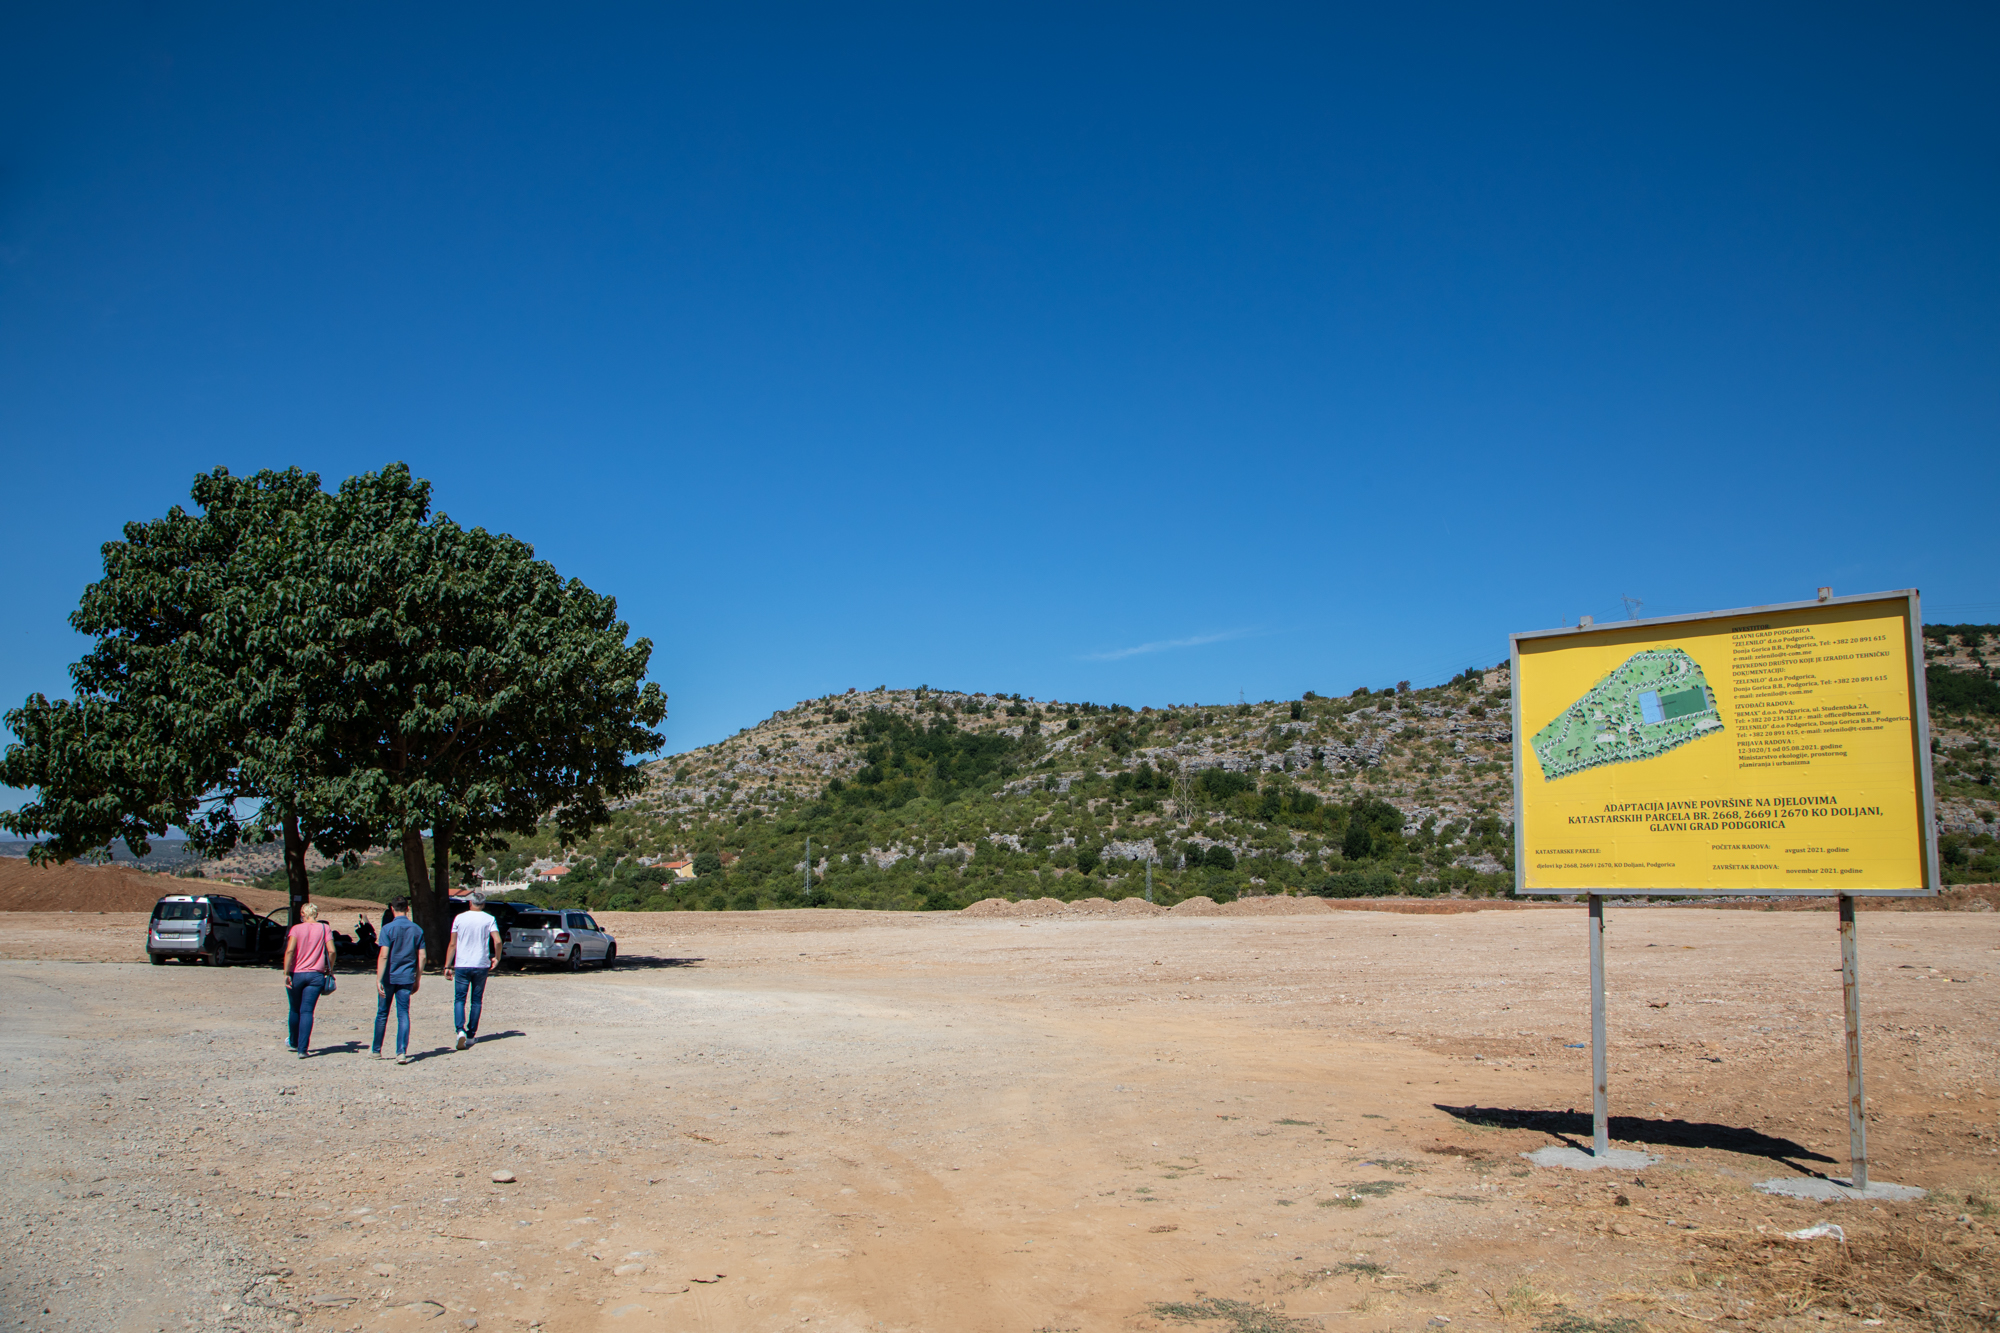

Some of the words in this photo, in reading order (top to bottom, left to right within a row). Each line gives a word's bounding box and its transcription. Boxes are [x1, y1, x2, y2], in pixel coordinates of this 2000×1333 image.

[1774, 628, 1810, 636] PODGORICA
[1604, 802, 1664, 812] ADAPTACIJA
[1666, 801, 1697, 811] JAVNE
[1700, 798, 1753, 809] POVRŠINE
[1773, 796, 1837, 807] DJELOVIMA
[1569, 814, 1643, 824] KATASTARSKIH
[1645, 812, 1690, 822] PARCELA
[1693, 812, 1710, 820] BR.
[1712, 811, 1742, 820] 2668,
[1744, 810, 1771, 818] 2669
[1781, 809, 1809, 817] 2670
[1812, 808, 1828, 817] KO
[1831, 807, 1883, 817] DOLJANI,
[1690, 822, 1718, 830] GRAD
[1721, 820, 1786, 830] PODGORICA
